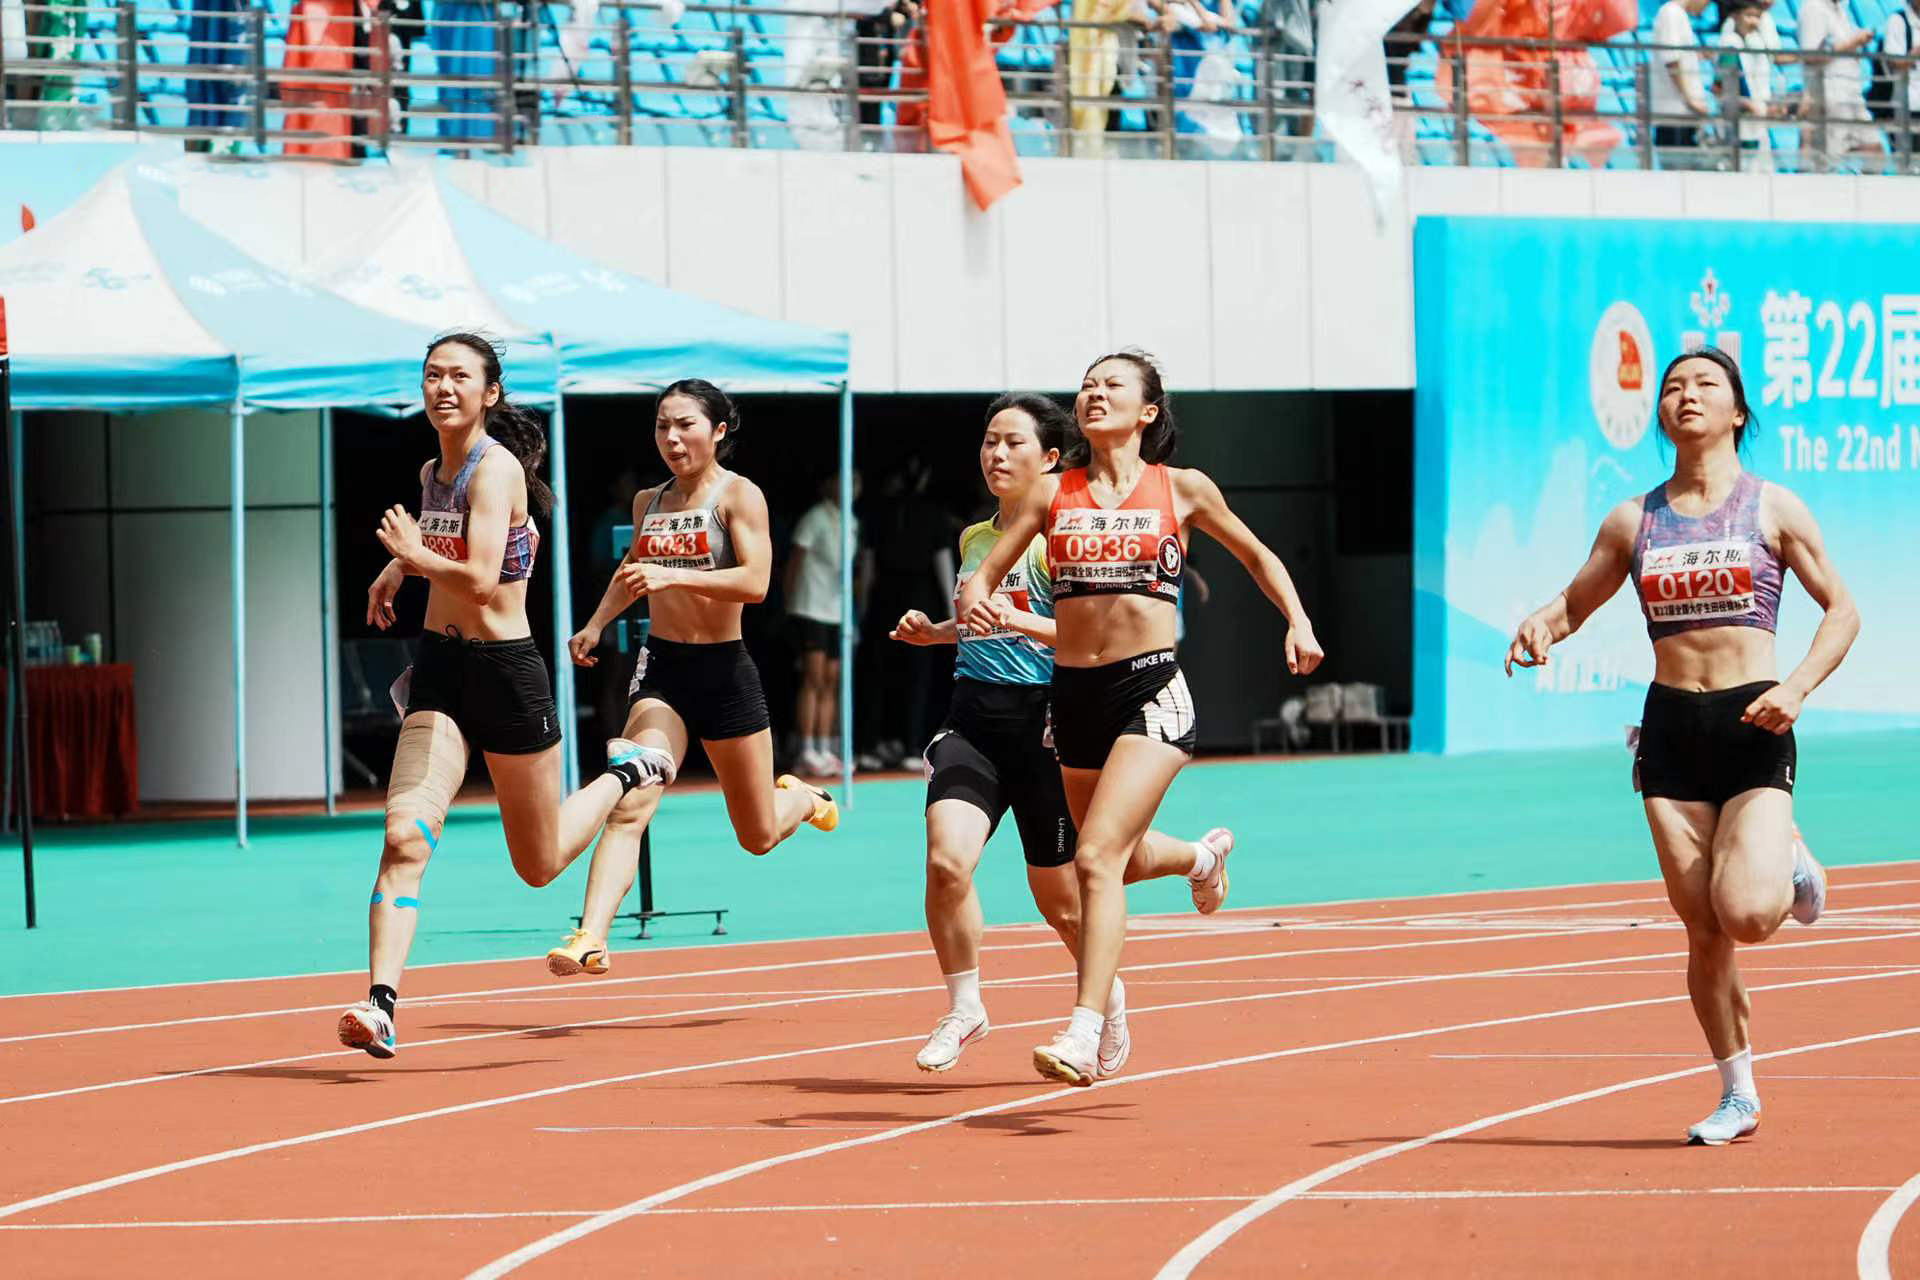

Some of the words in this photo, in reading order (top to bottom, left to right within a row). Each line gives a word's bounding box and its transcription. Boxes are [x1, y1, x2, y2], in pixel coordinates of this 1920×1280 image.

[1780, 425, 1829, 471] The
[1837, 424, 1900, 471] 22nd
[429, 516, 461, 534] 海尔斯
[668, 515, 704, 532] 海尔斯
[1090, 515, 1152, 531] 海尔斯
[1065, 535, 1141, 562] 0936
[1681, 549, 1742, 568] 海尔斯
[1658, 568, 1735, 600] 0120
[1131, 654, 1159, 671] NIKE
[1160, 652, 1175, 663] PR
